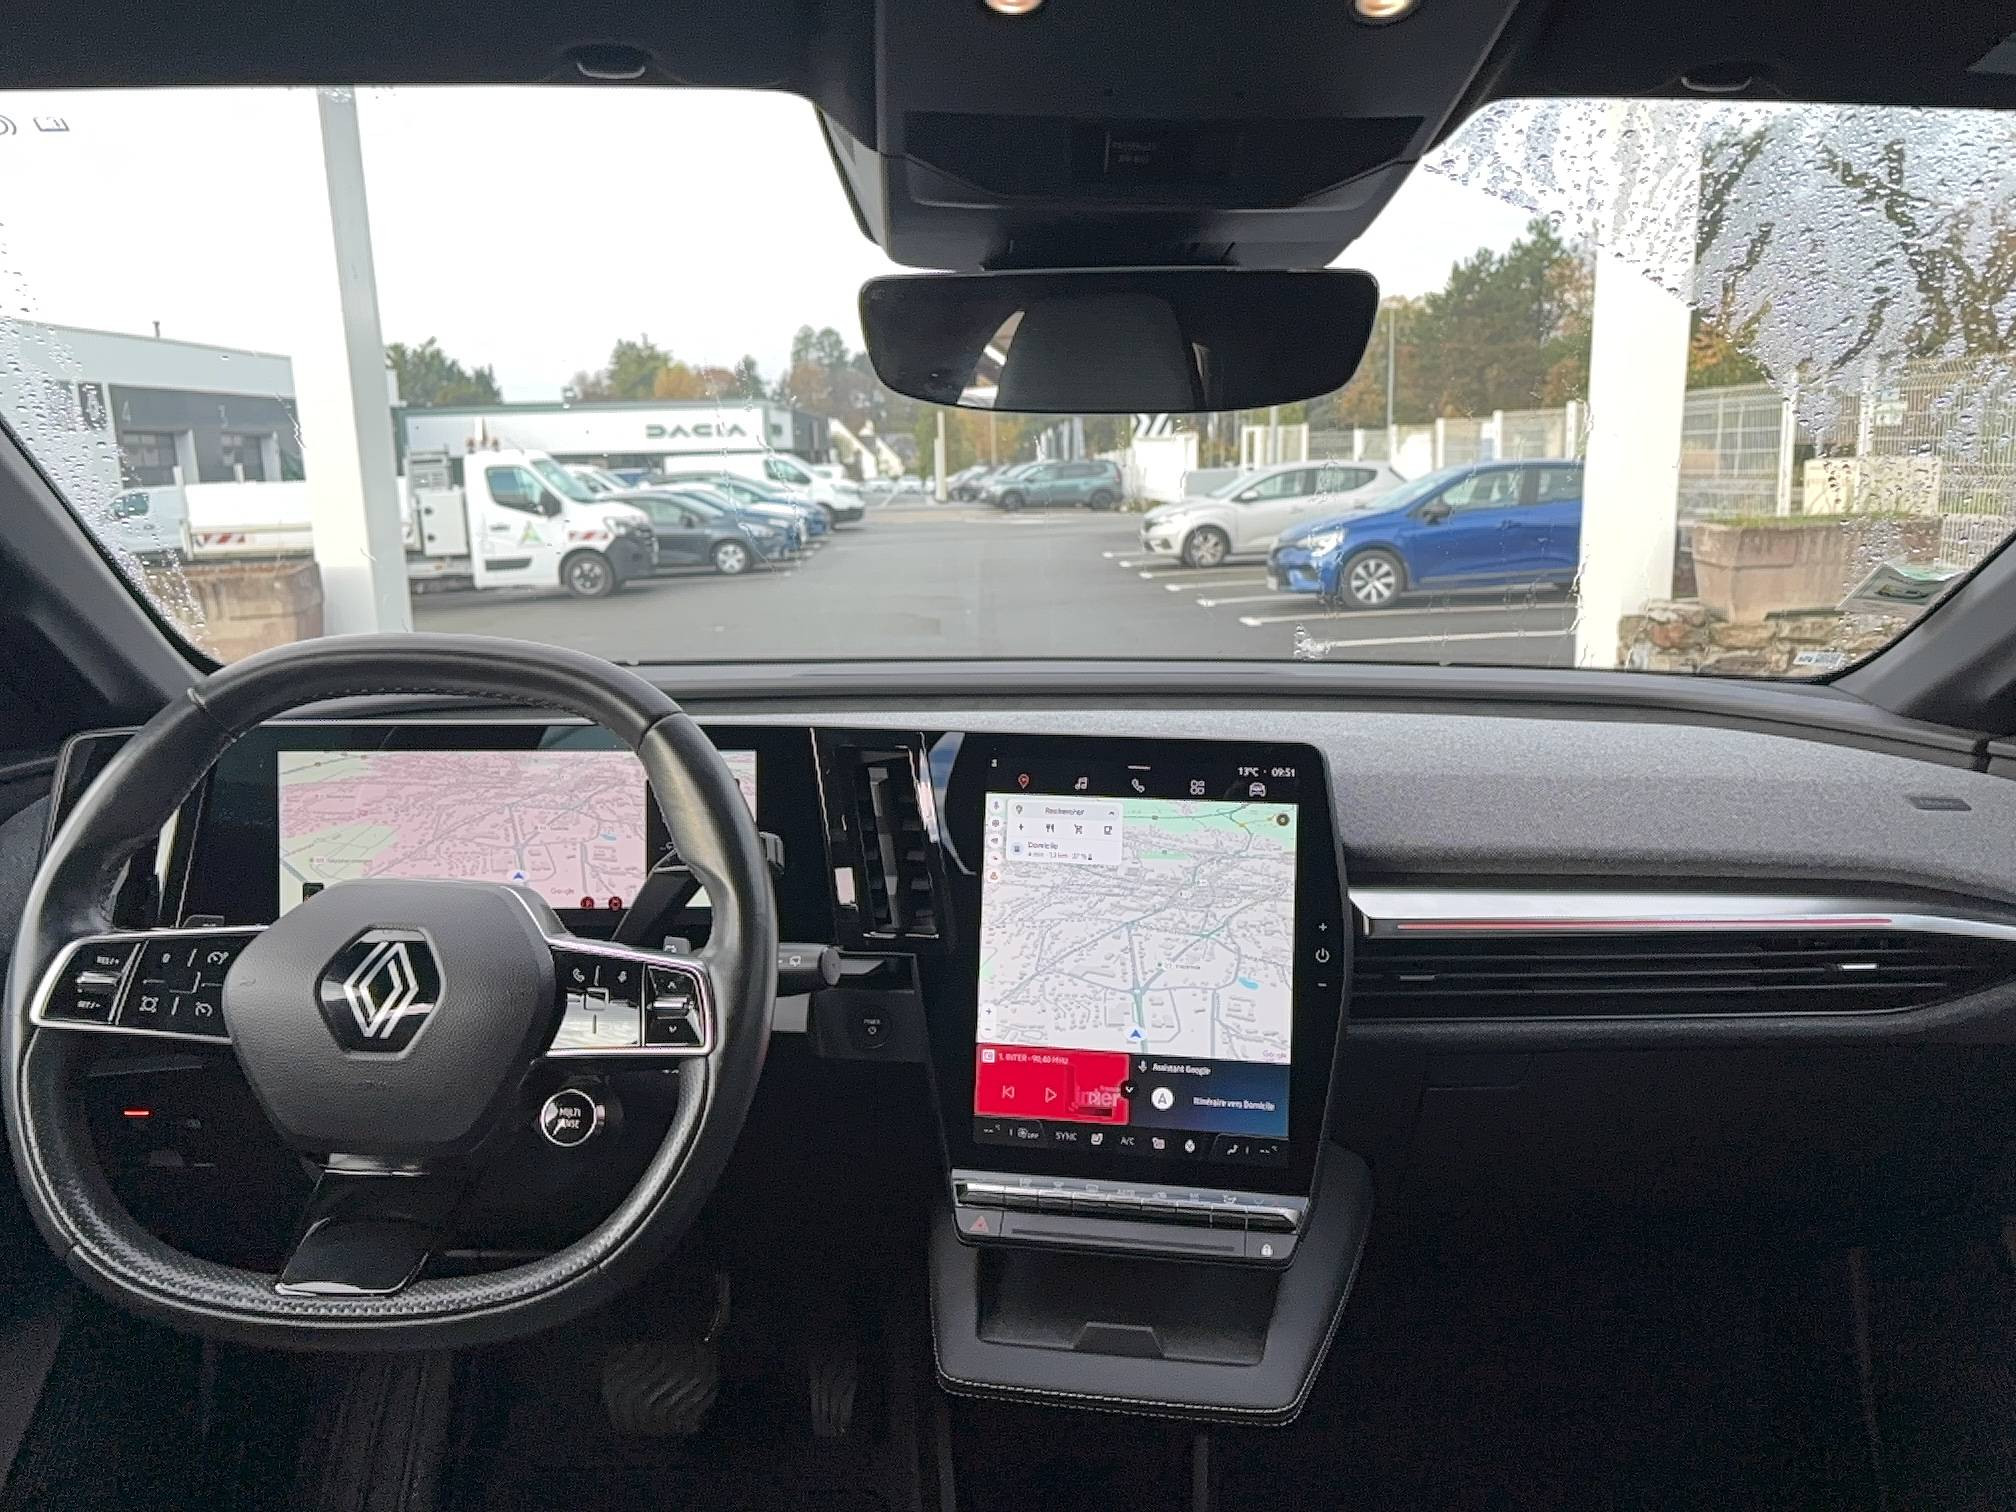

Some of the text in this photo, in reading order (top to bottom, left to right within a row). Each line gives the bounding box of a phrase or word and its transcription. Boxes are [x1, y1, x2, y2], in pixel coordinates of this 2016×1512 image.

[645, 423, 748, 439] DACIA
[1055, 1131, 1078, 1141] SYNC
[1120, 1136, 1136, 1146] A/C
